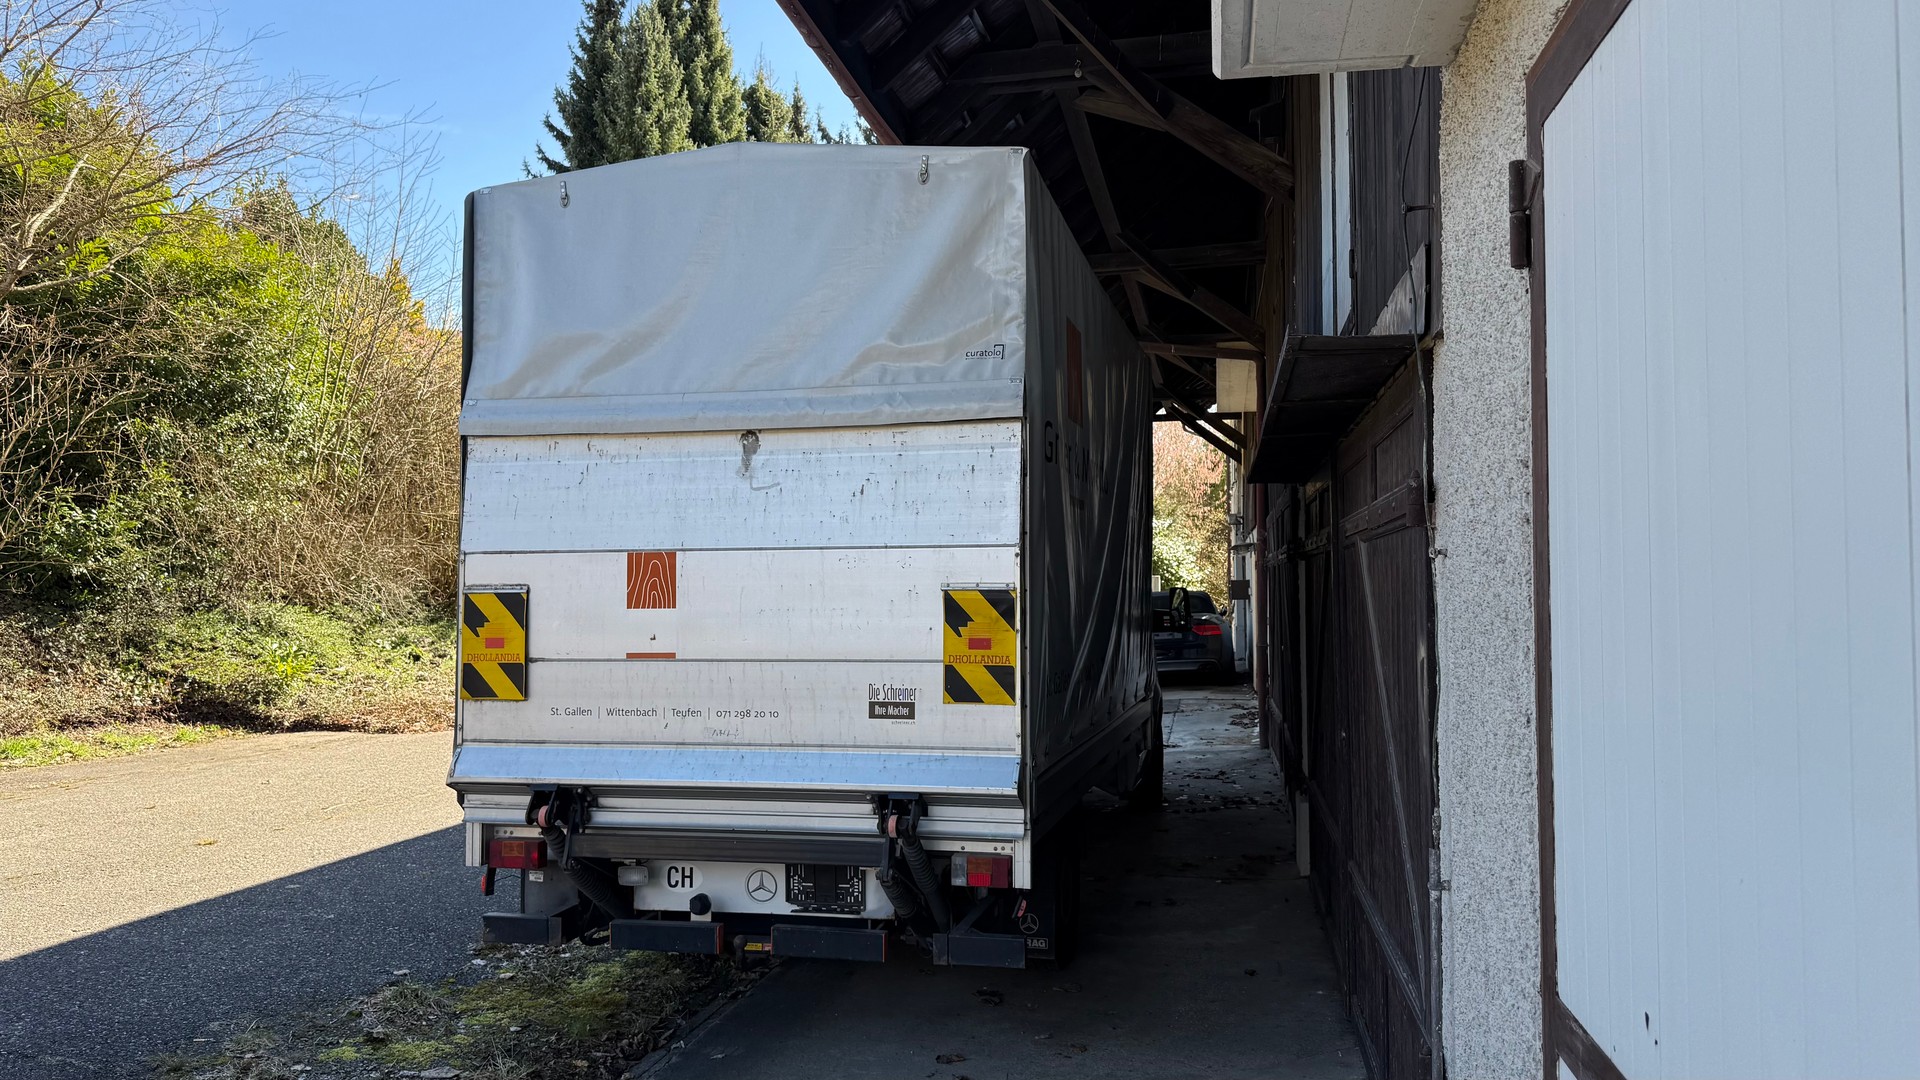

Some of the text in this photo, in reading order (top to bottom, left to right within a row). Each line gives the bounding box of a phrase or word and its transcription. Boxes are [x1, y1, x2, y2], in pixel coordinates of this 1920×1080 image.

[965, 347, 1002, 358] curatolo
[466, 653, 521, 662] DHOLLANDIA
[948, 654, 1011, 665] DHOLLANDIA
[868, 683, 917, 701] Die Schreiner
[550, 706, 562, 716] St.
[564, 706, 593, 716] Gallen
[606, 707, 658, 717] Wittenbach
[716, 710, 731, 719] 071
[734, 709, 751, 720] 298
[754, 710, 766, 719] 20
[769, 710, 779, 719] 10
[874, 704, 910, 716] Ihre Macher
[667, 866, 694, 889] CH
[1026, 937, 1046, 948] RAG
